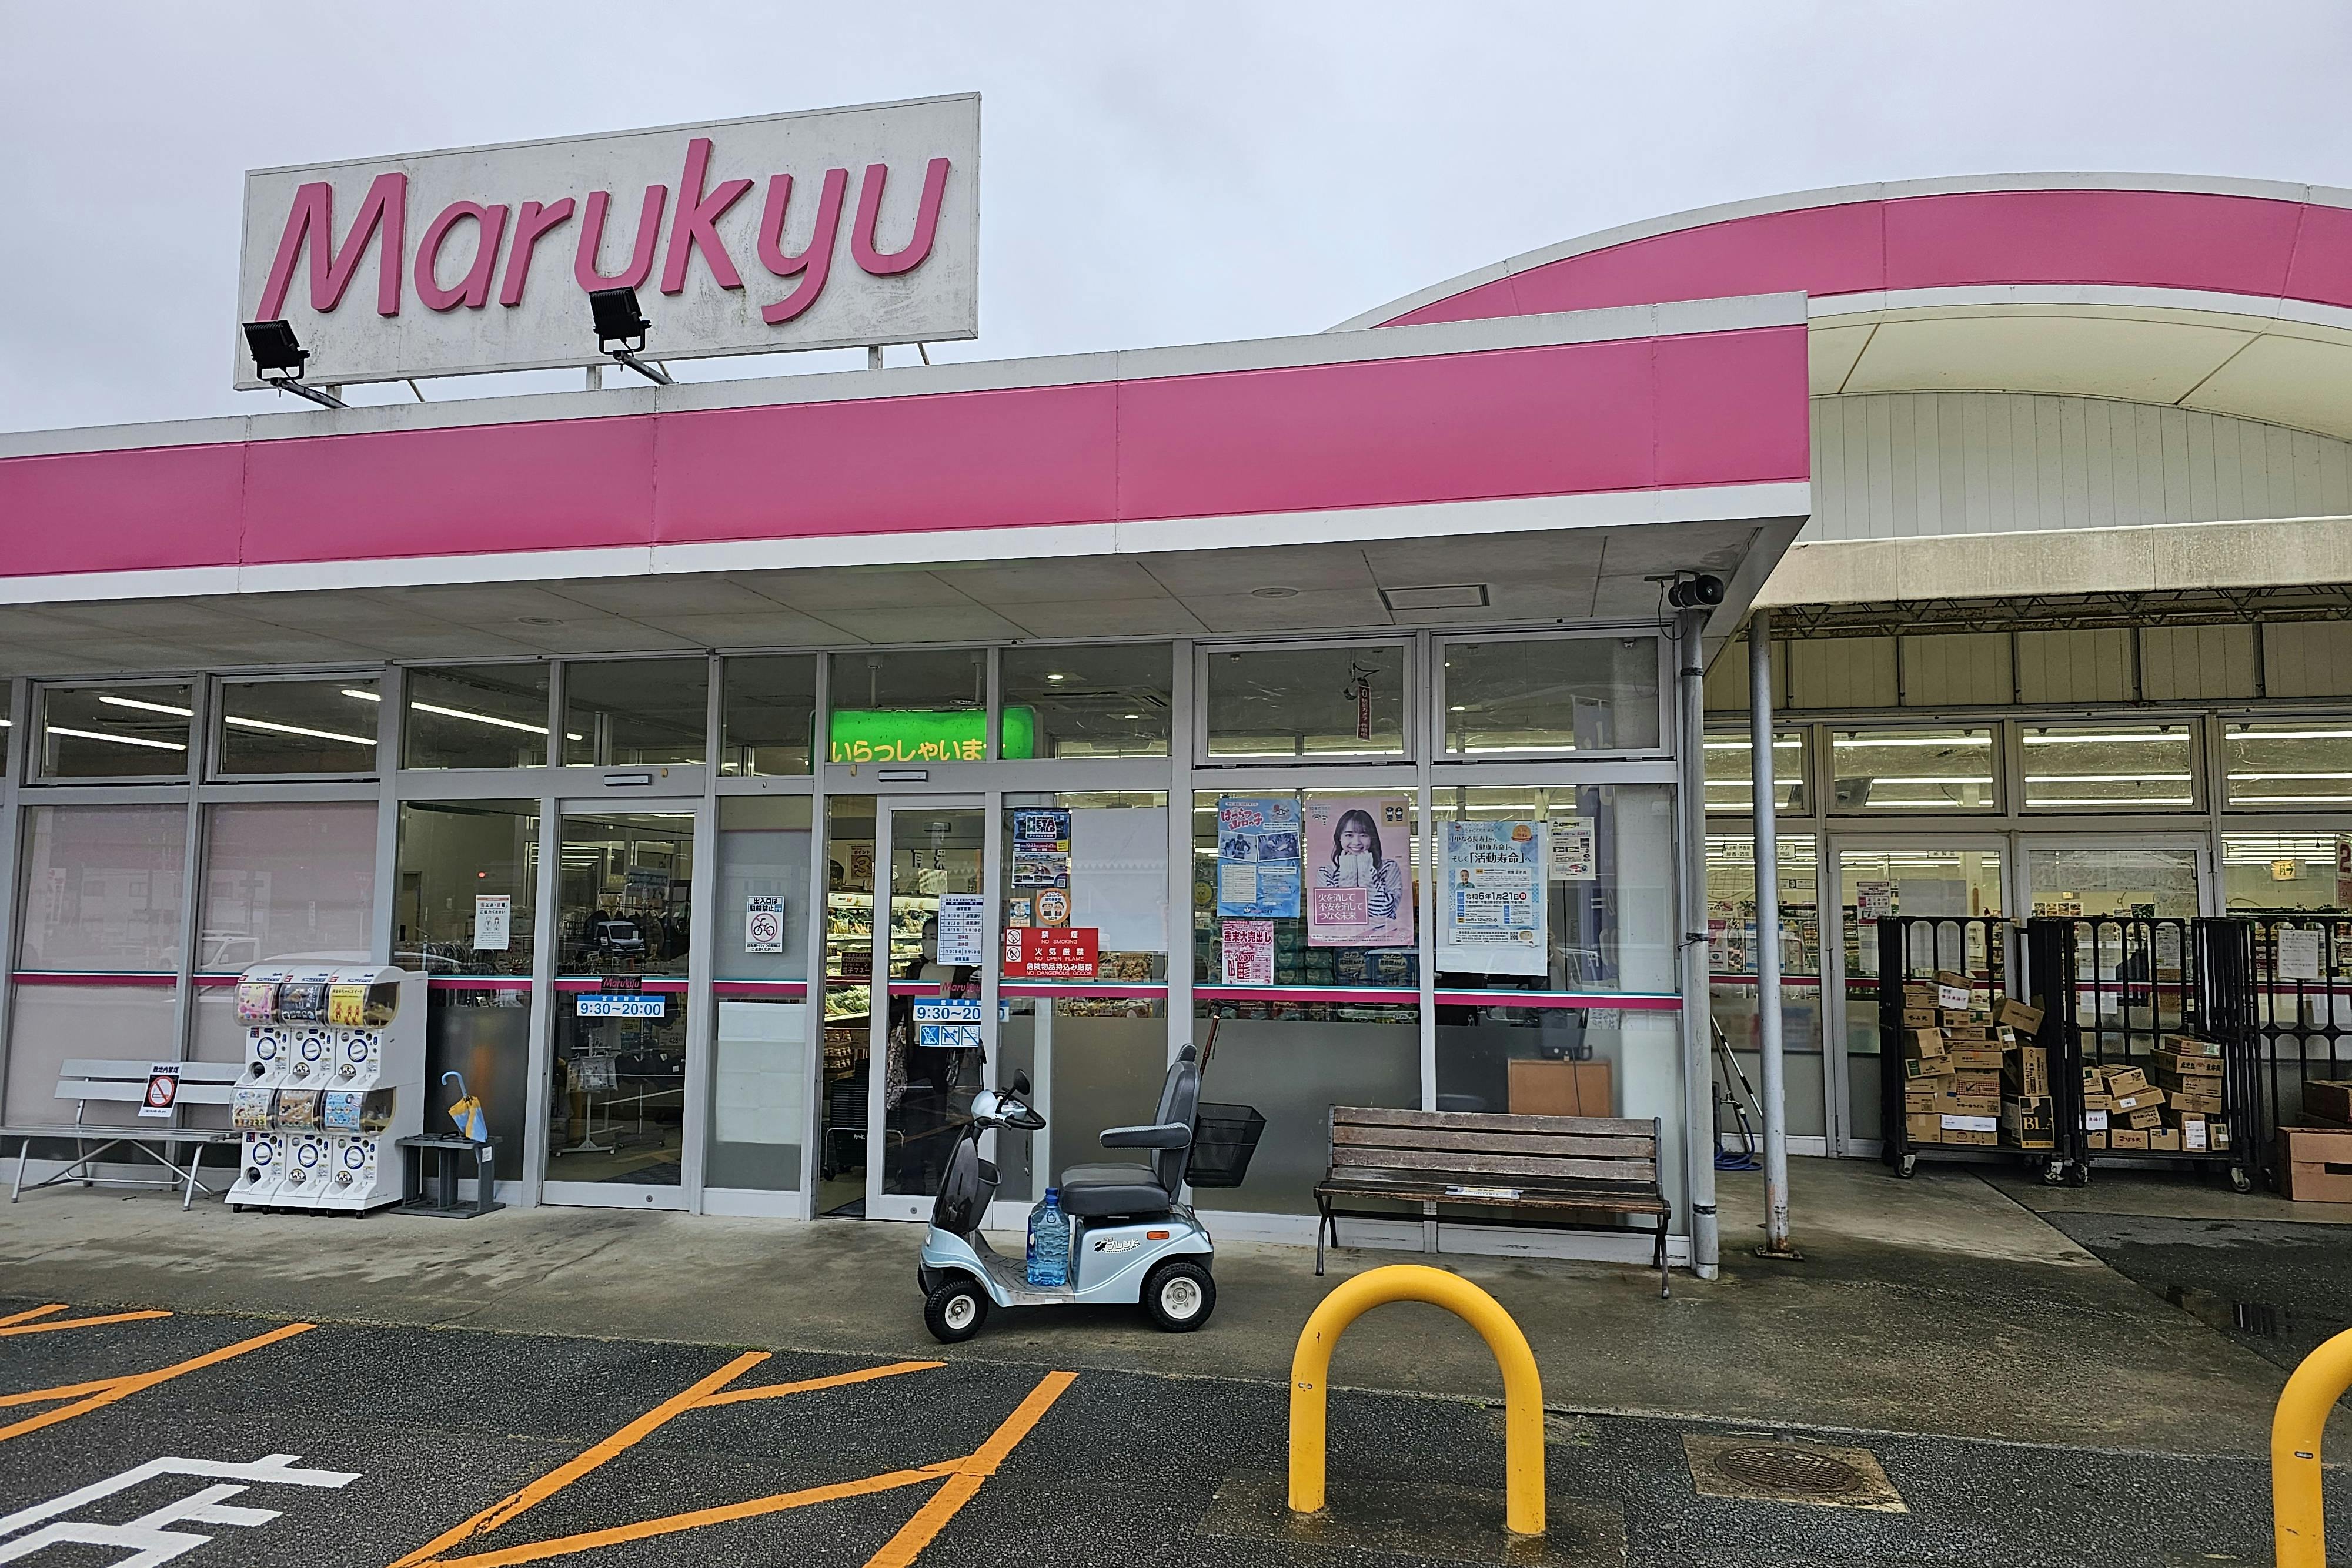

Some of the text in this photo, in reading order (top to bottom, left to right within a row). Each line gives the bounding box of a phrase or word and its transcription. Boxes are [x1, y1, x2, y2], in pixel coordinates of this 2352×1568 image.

[255, 138, 951, 326] Marukyu
[832, 739, 987, 763] いらっしゃいま
[1452, 852, 1532, 864] そして「活動寿命」へ
[1318, 893, 1355, 901] 火を消して
[1319, 902, 1364, 911] 不安を消して
[1319, 912, 1357, 920] つなぐ未来
[1026, 962, 1092, 971] 危険物品持込み厳禁
[603, 978, 640, 988] Marukyu
[580, 1002, 661, 1015] 9:30~20:00
[1106, 1239, 1140, 1251] フレンド
